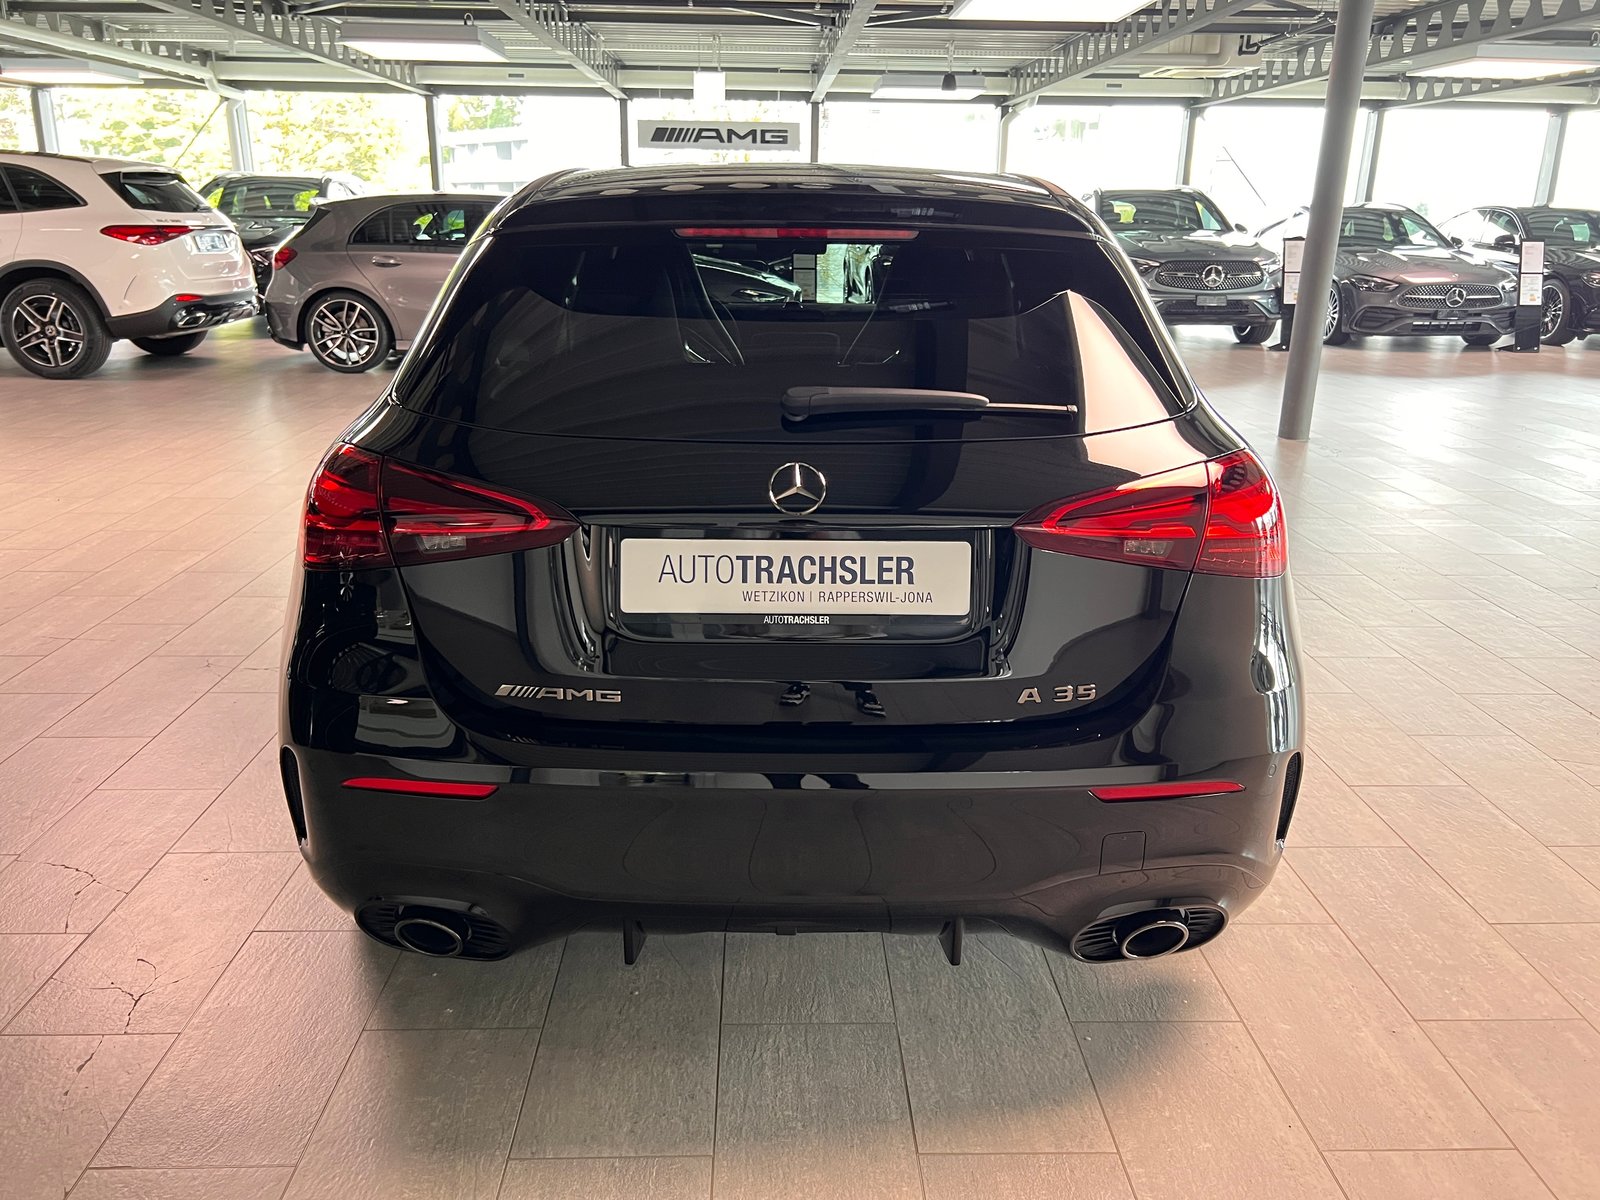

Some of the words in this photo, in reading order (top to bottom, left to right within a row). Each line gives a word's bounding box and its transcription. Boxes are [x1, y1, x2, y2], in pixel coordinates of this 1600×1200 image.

[692, 127, 788, 145] AMG
[658, 554, 915, 585] AUTOTRACHSLER
[742, 590, 805, 603] WETZIKON
[818, 591, 933, 604] RAPPERSWIL-JONA
[763, 615, 830, 625] AUTOTRACHSLER
[535, 687, 622, 703] AMG
[1017, 687, 1042, 704] A
[1053, 684, 1097, 702] 35
